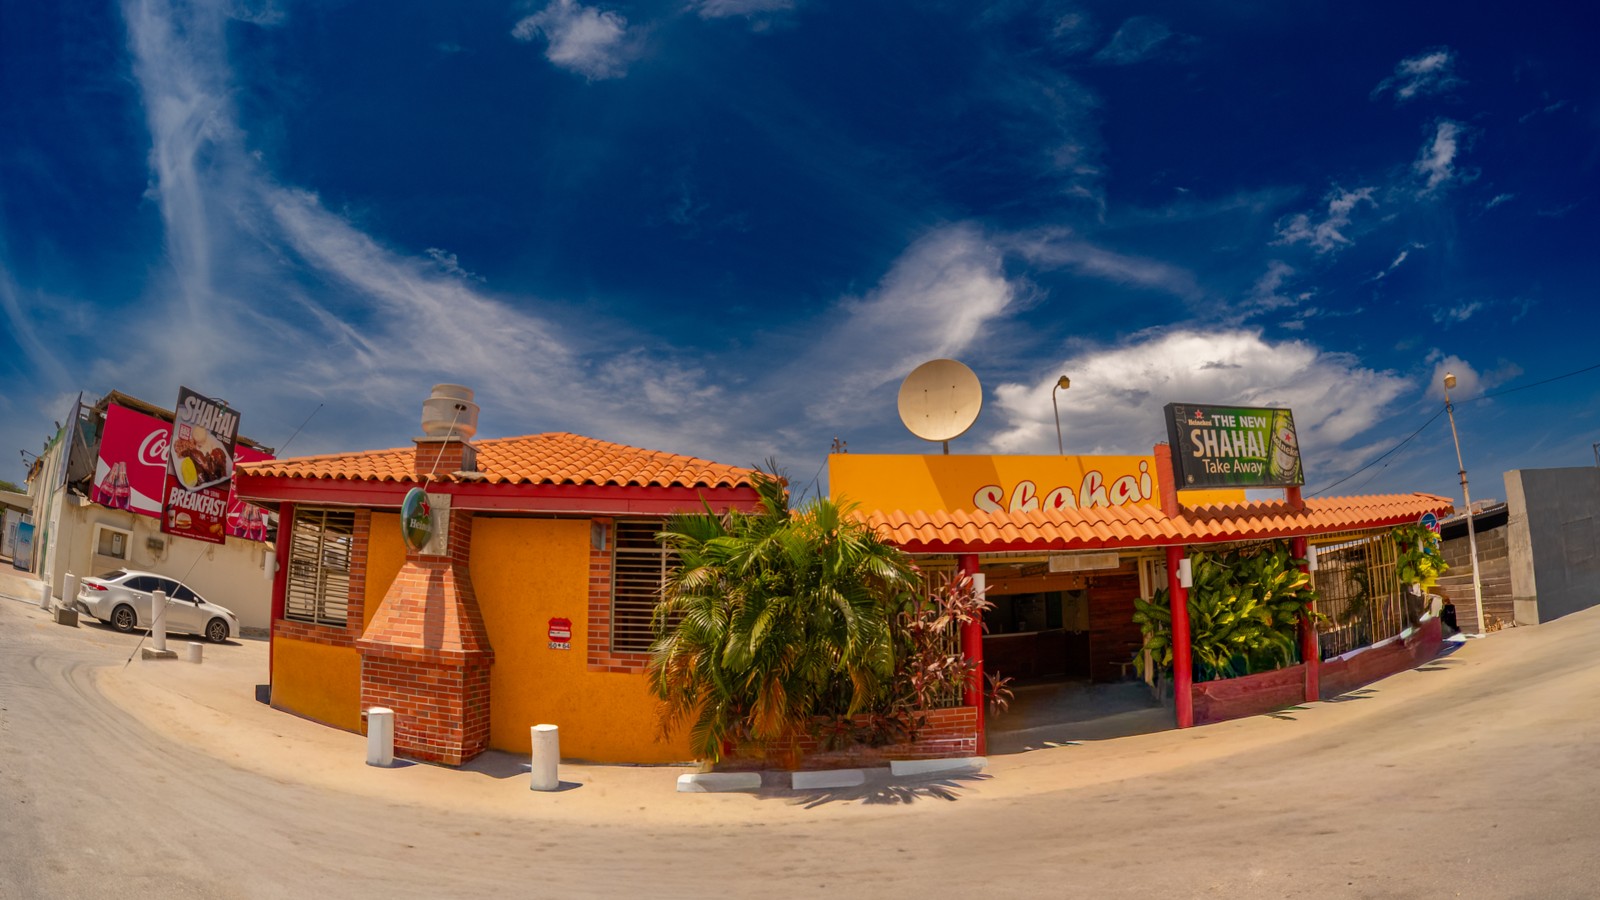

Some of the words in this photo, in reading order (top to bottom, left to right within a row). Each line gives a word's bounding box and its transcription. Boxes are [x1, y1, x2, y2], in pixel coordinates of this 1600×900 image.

[183, 396, 237, 438] SHAHAI
[1211, 414, 1236, 427] THE
[1239, 416, 1266, 428] NEW
[1190, 428, 1266, 457] SHAHAI
[1202, 459, 1230, 473] Take
[1234, 459, 1263, 476] Away
[168, 486, 227, 518] BREAKFAST
[973, 460, 1152, 514] Shahai
